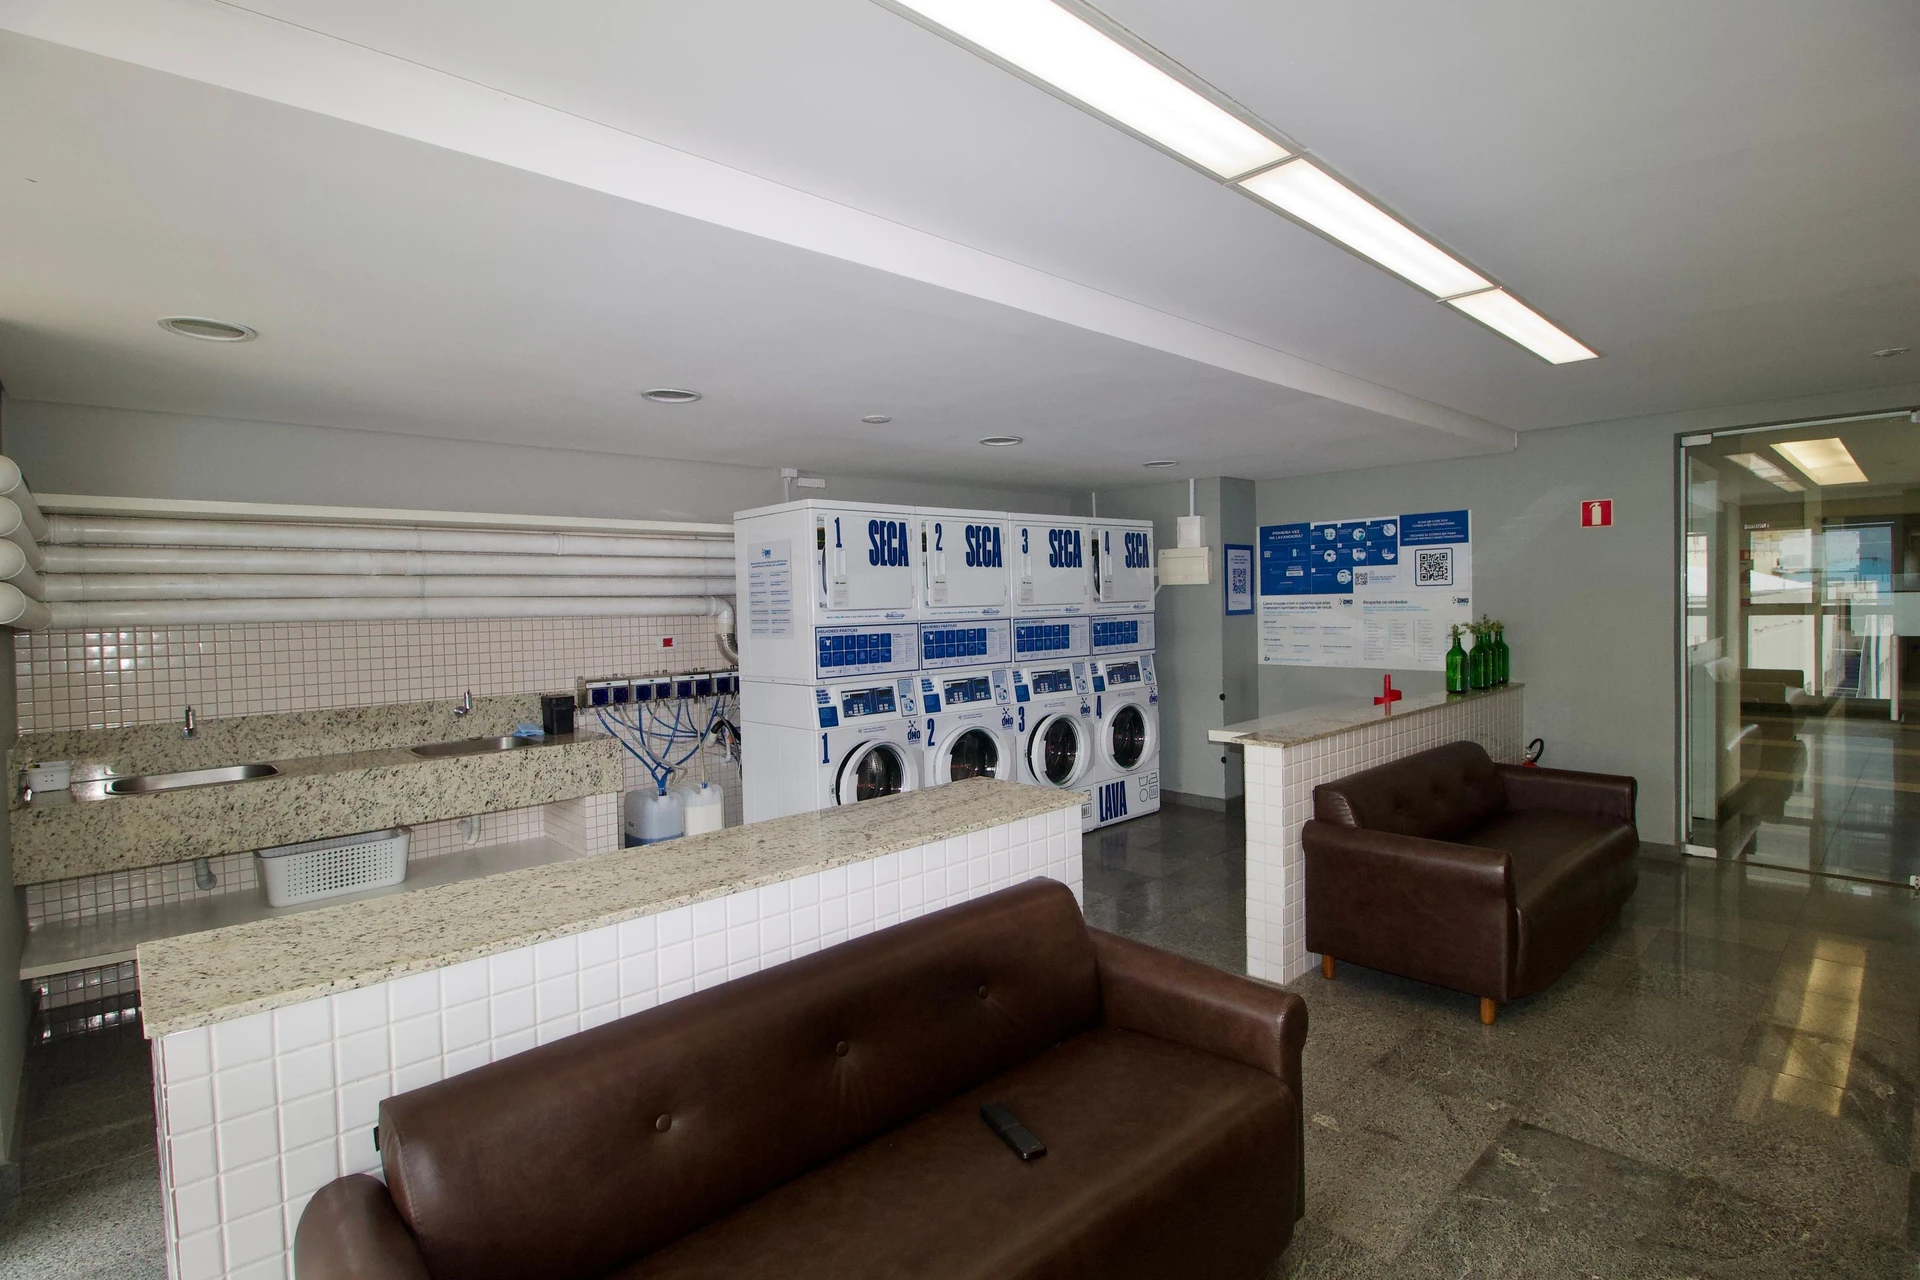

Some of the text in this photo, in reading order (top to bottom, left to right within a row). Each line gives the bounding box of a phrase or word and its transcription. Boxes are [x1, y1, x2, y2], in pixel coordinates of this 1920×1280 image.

[834, 517, 842, 548] 1
[868, 519, 909, 566] SECA
[935, 522, 943, 551] 2
[965, 524, 1003, 568] SECA
[1021, 528, 1028, 554] 3
[1048, 528, 1082, 568] SECA
[1105, 531, 1110, 555] 4
[1124, 532, 1149, 568] SECA
[926, 718, 935, 747] 2
[1018, 706, 1025, 732] 3
[822, 733, 830, 764] 1
[1098, 780, 1128, 822] LAVA
